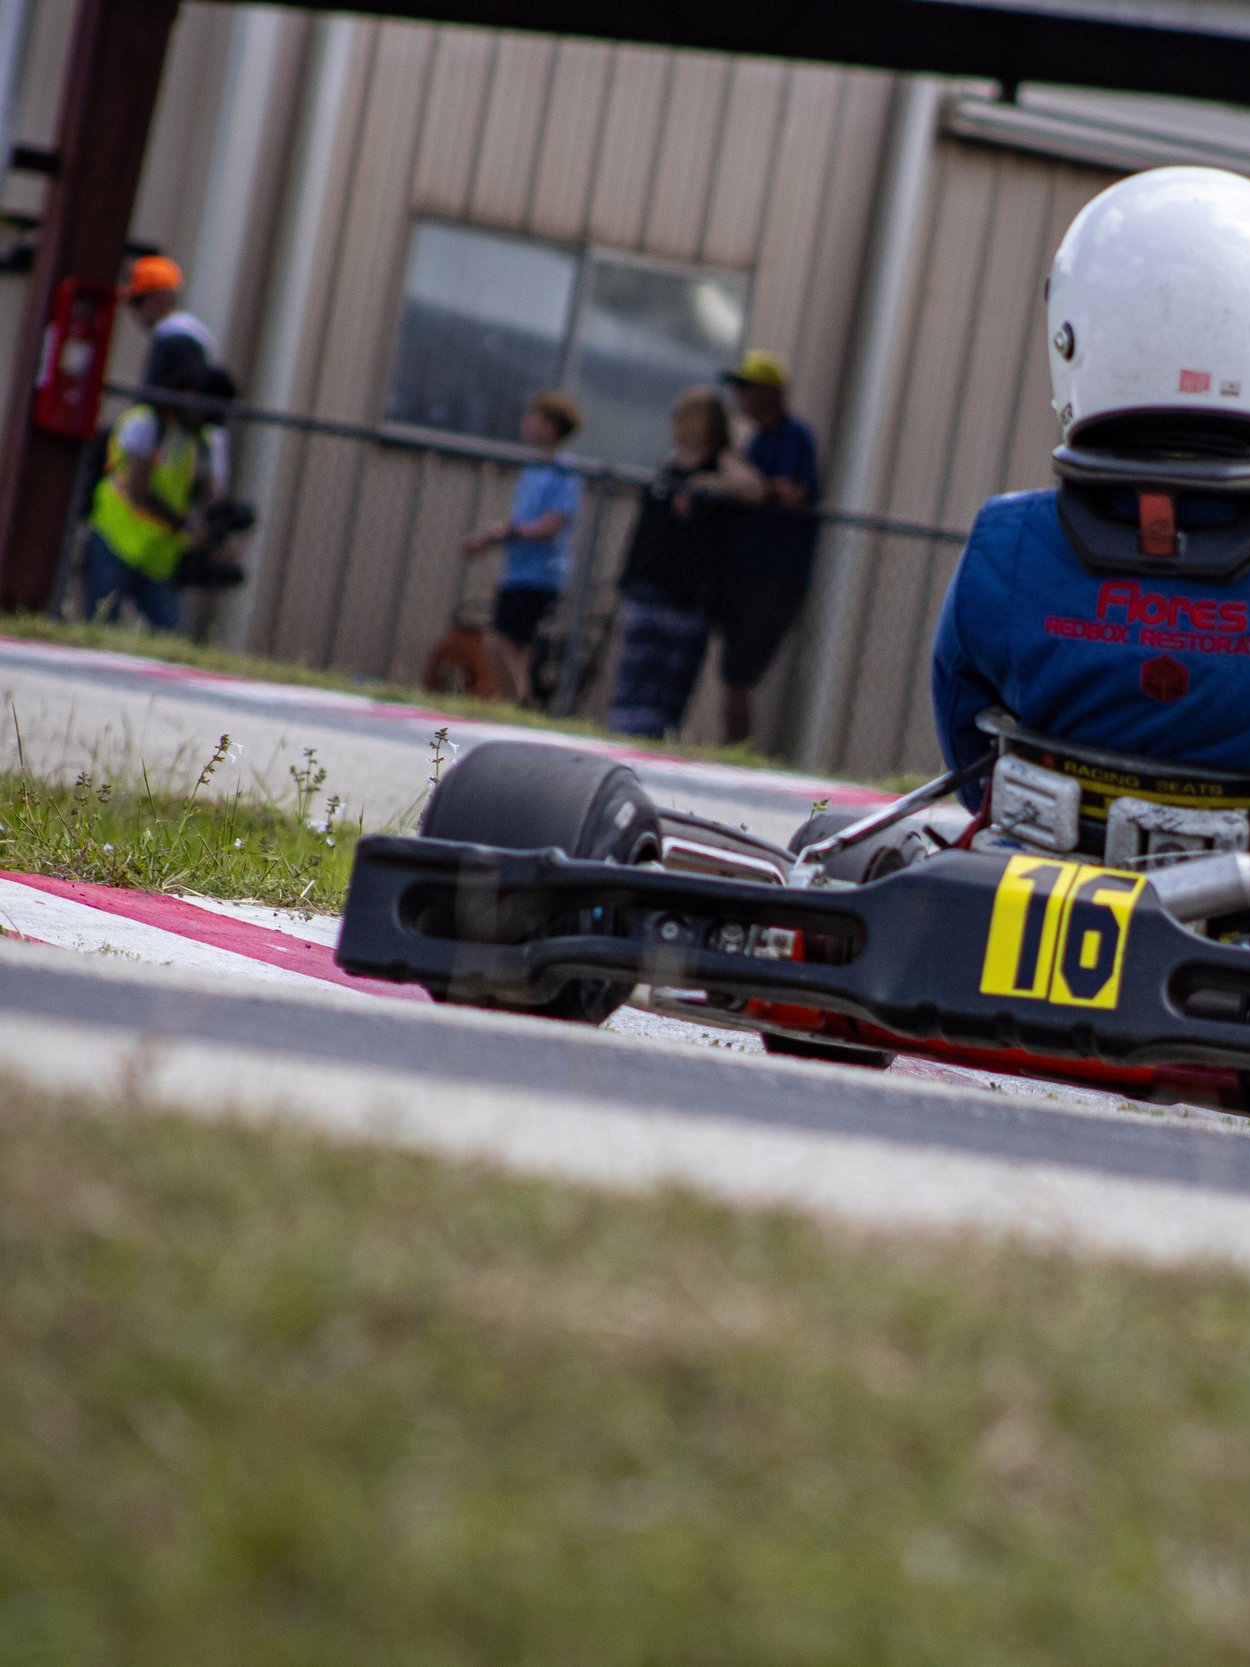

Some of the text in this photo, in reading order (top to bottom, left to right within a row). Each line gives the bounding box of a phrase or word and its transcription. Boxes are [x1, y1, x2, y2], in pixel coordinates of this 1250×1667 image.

[1045, 615, 1129, 645] REDBOX
[1063, 760, 1141, 789] RACING
[1155, 779, 1225, 797] SEATS
[1012, 861, 1139, 1001] 16
